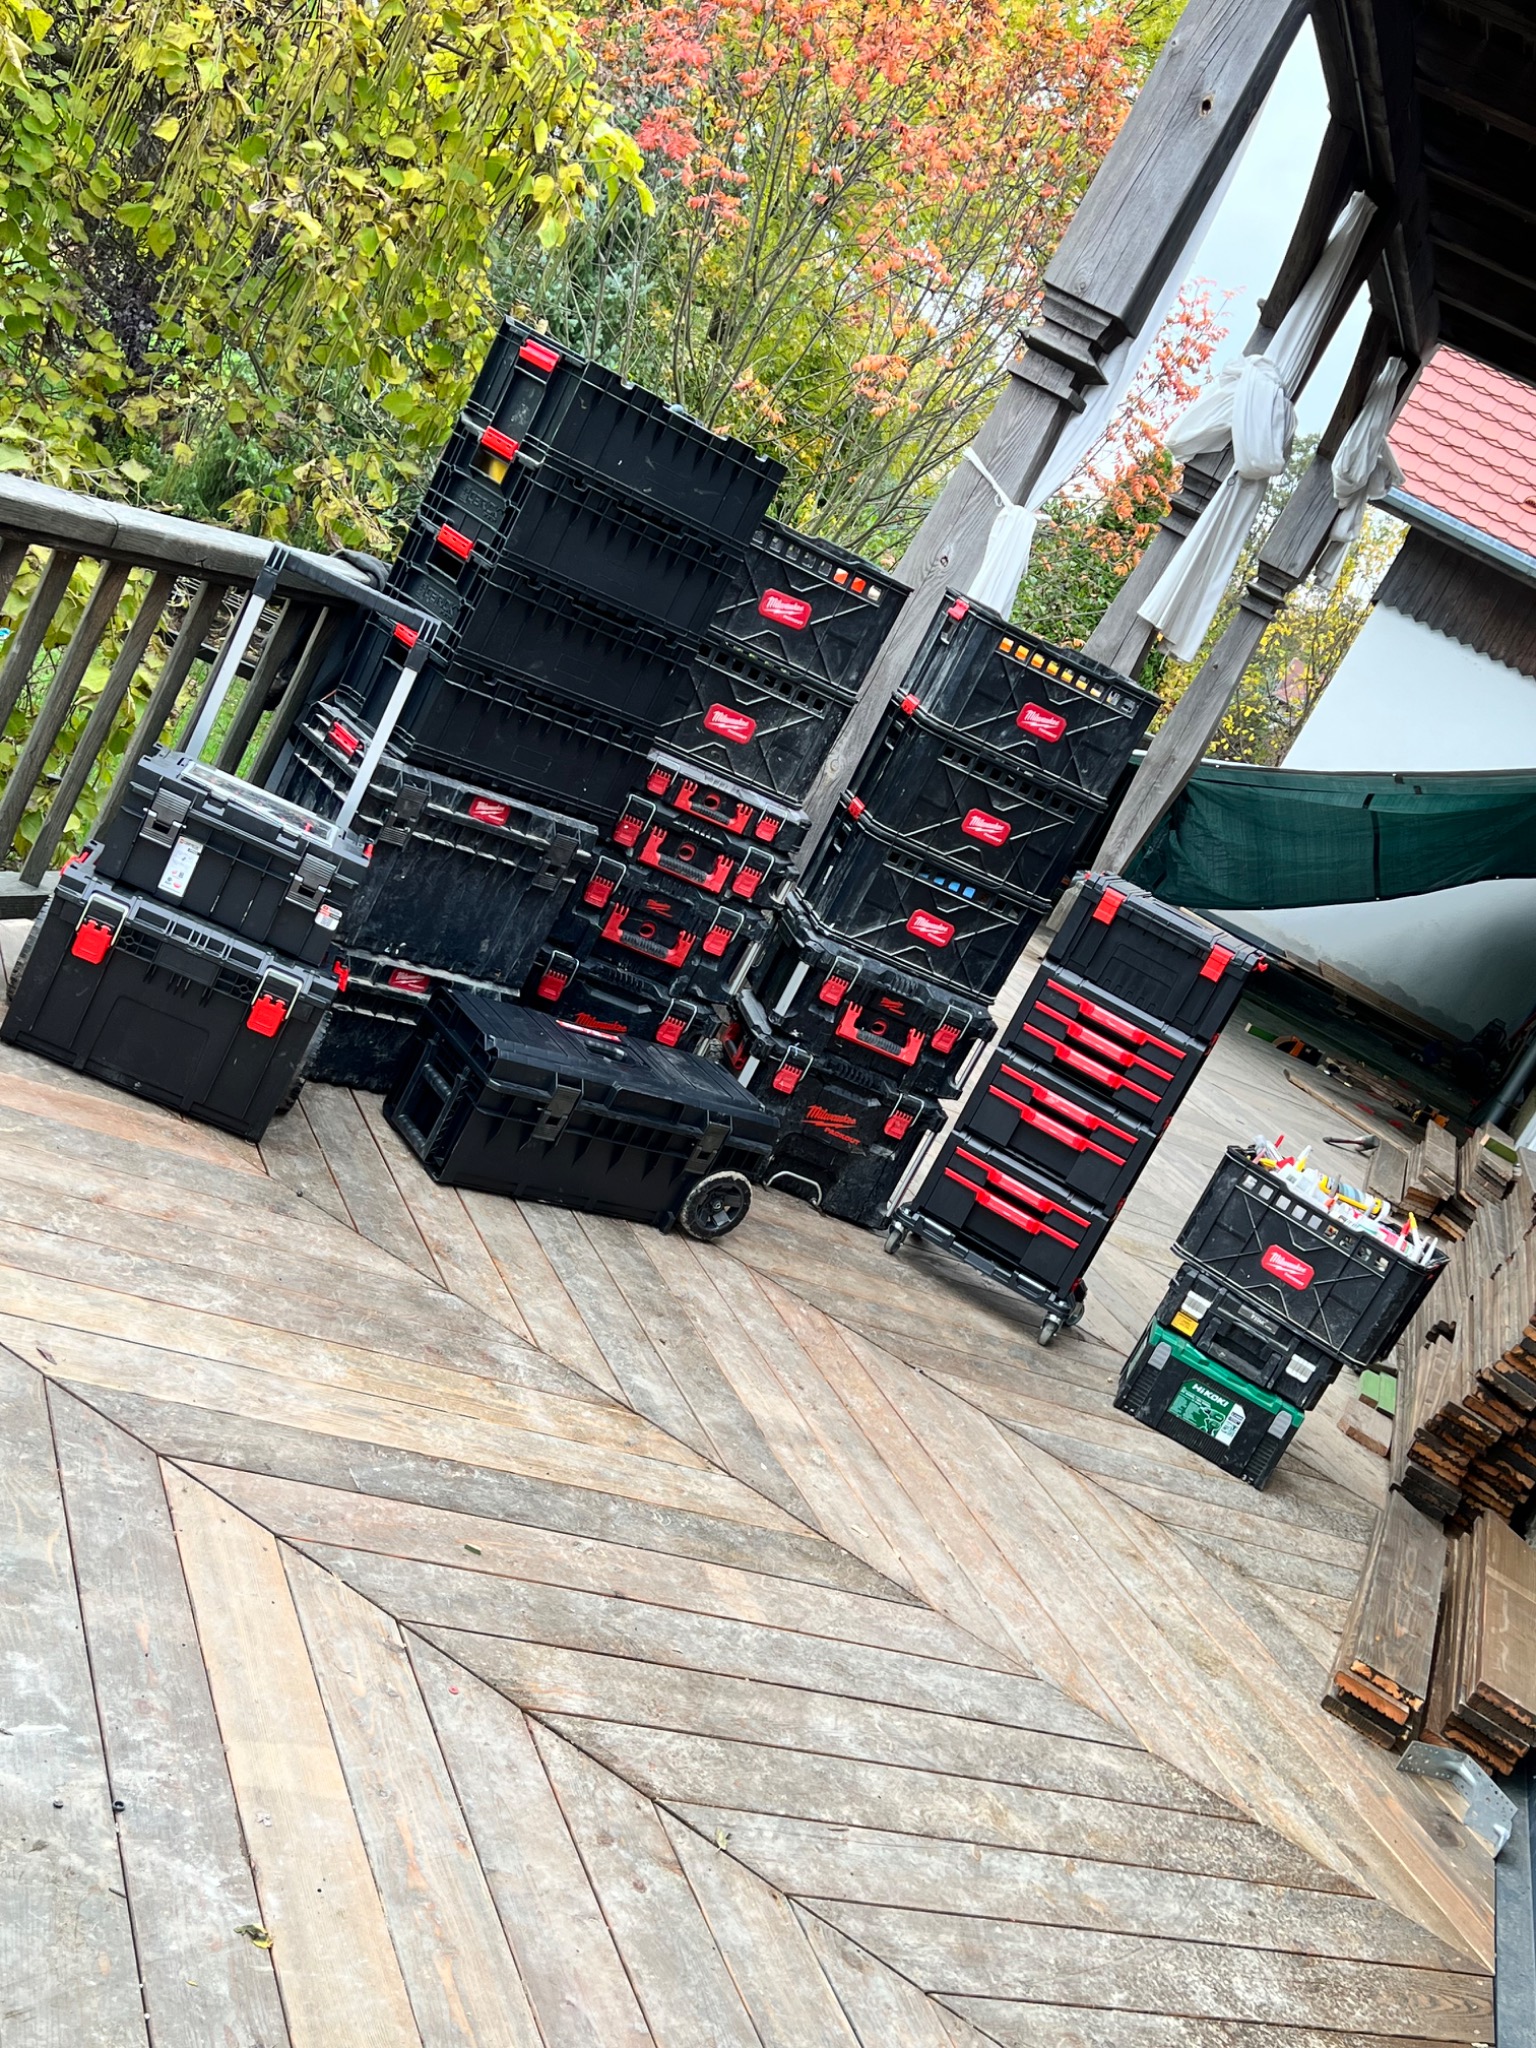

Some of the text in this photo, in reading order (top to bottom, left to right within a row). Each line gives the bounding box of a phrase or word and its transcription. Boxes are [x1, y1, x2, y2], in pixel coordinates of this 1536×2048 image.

[766, 595, 805, 612] Milwaukee
[711, 710, 750, 727] Milwaukee
[1023, 709, 1061, 727] Milwaukee
[968, 815, 1005, 831] Milwaukee
[913, 915, 949, 932] Milwaukee
[575, 1011, 628, 1033] Milwaukee
[806, 1103, 858, 1126] Milwaukee
[823, 1126, 862, 1146] PACKOUT
[1268, 1251, 1307, 1273] Milwaukee
